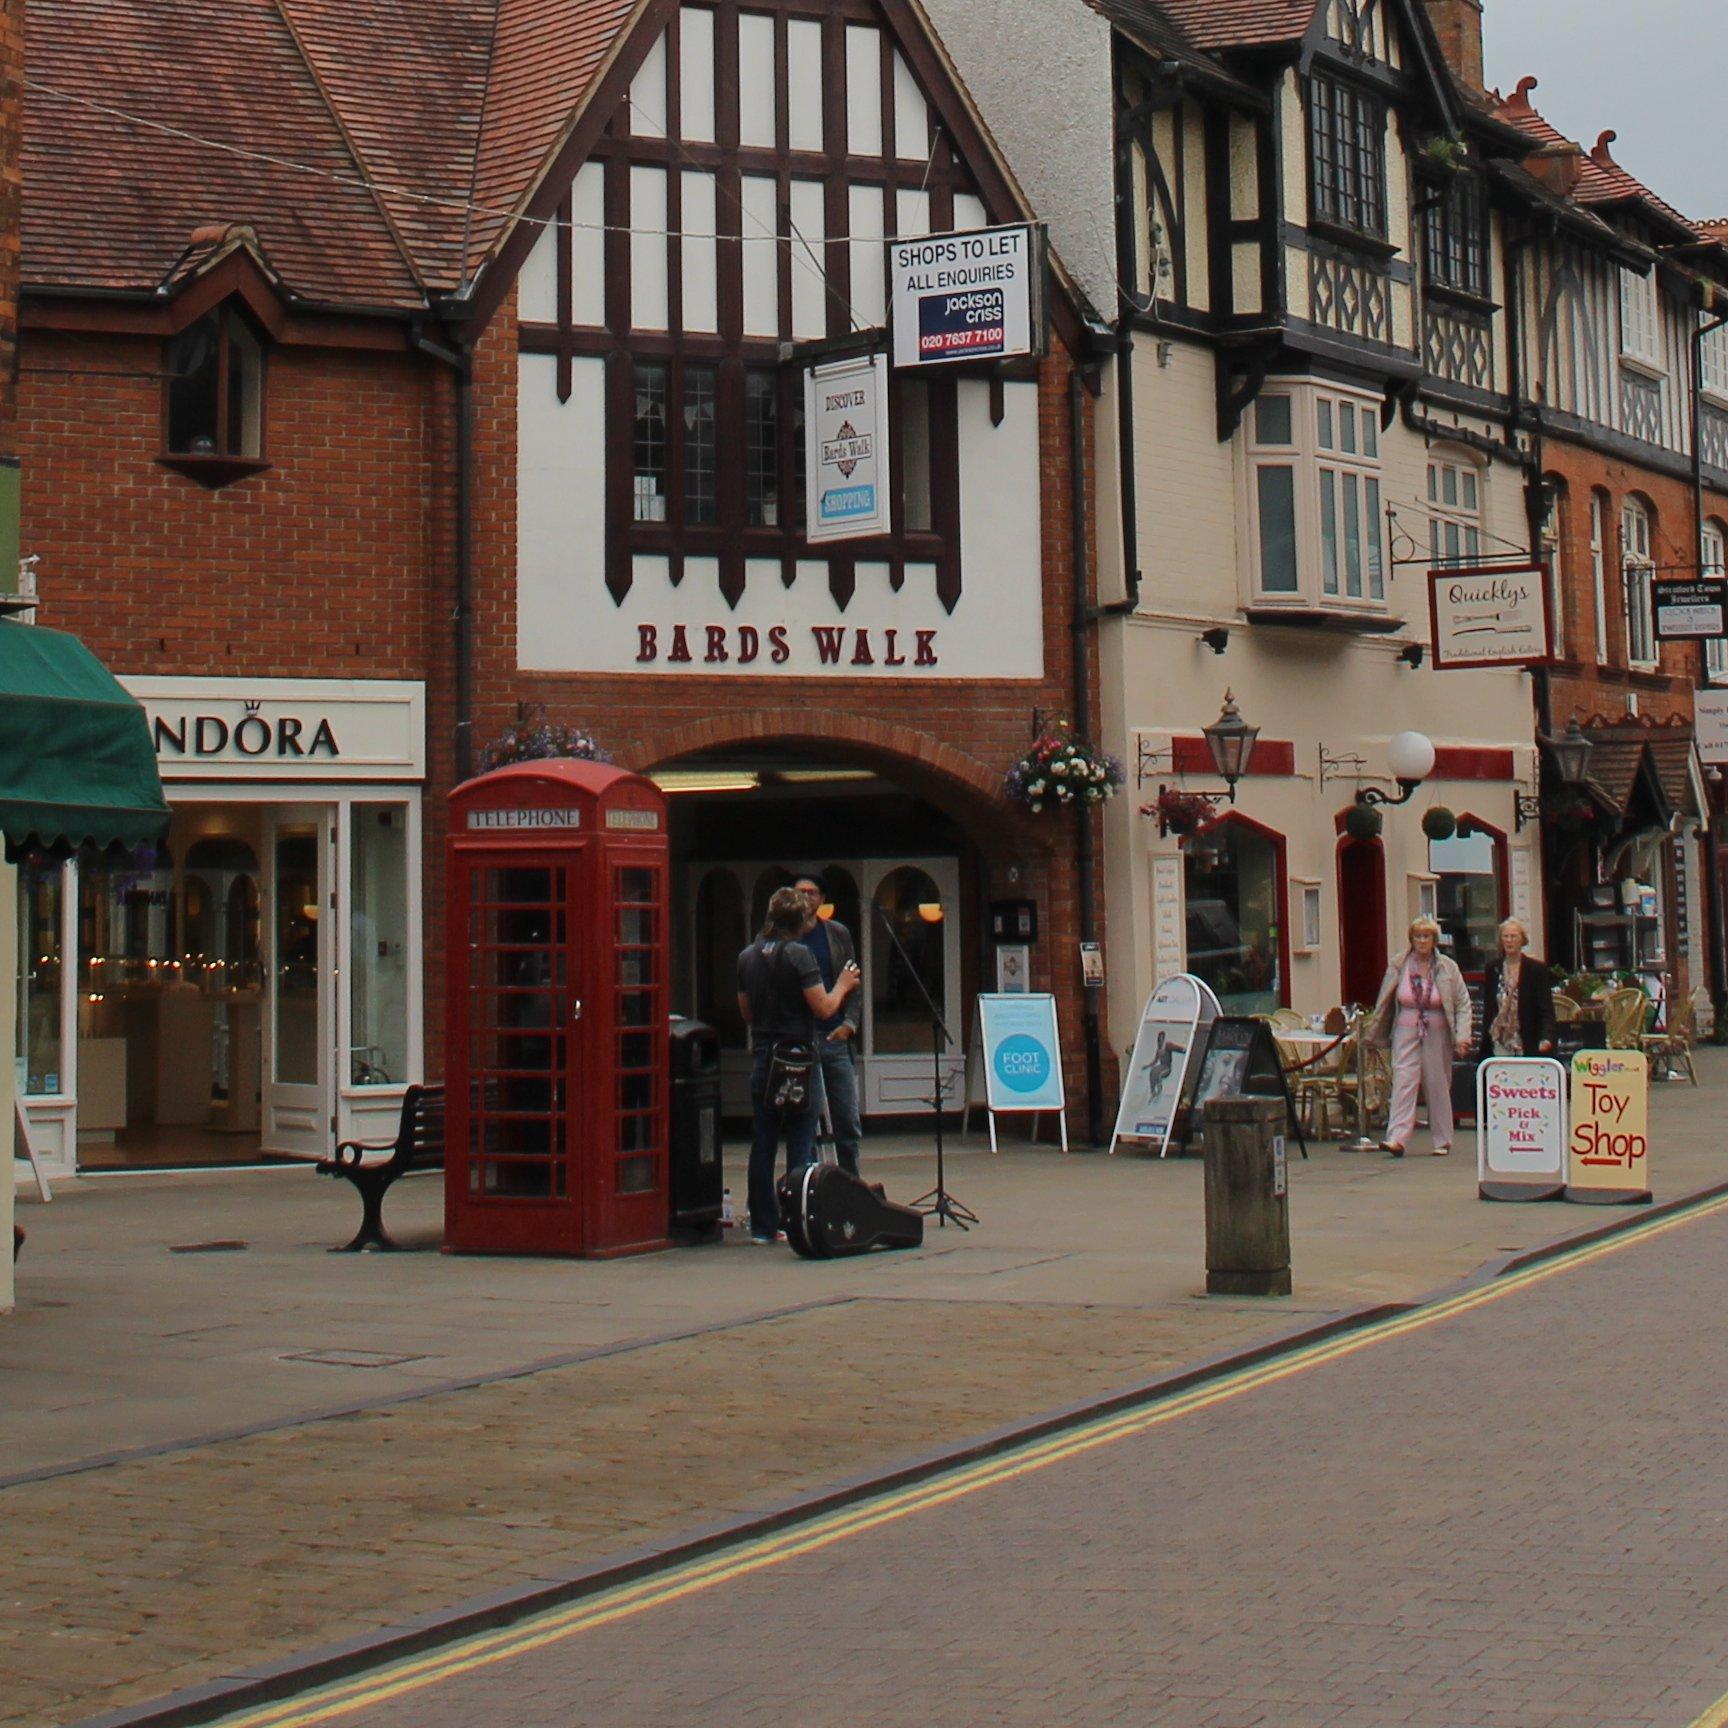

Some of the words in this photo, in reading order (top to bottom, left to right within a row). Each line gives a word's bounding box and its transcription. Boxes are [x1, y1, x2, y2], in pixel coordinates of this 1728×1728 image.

[899, 243, 957, 268] SHOPS
[961, 239, 984, 260] TO
[989, 235, 1020, 256] LET
[907, 274, 934, 292] ALL
[938, 263, 1015, 288] ENQUIRIES
[945, 292, 1002, 316] jackson
[966, 307, 1002, 323] criss
[922, 336, 943, 349] 020
[945, 331, 971, 347] 7637
[975, 327, 1002, 342] 7100
[825, 390, 866, 412] DISCOVER
[824, 444, 847, 461] Bards
[849, 438, 871, 456] Walk
[824, 489, 871, 513] SHOPPING
[1449, 578, 1529, 609] Quicklys
[635, 624, 791, 664] BARDS
[811, 626, 939, 666] WALK
[475, 810, 578, 827] TELEPHONE
[1003, 1052, 1040, 1064] FOOT
[1004, 1064, 1041, 1074] CLINIC
[1489, 1084, 1557, 1100] Sweets
[1583, 1082, 1630, 1124] Toy
[1508, 1107, 1541, 1119] Pick
[1509, 1130, 1535, 1142] Mix
[1571, 1120, 1646, 1169] Shop
